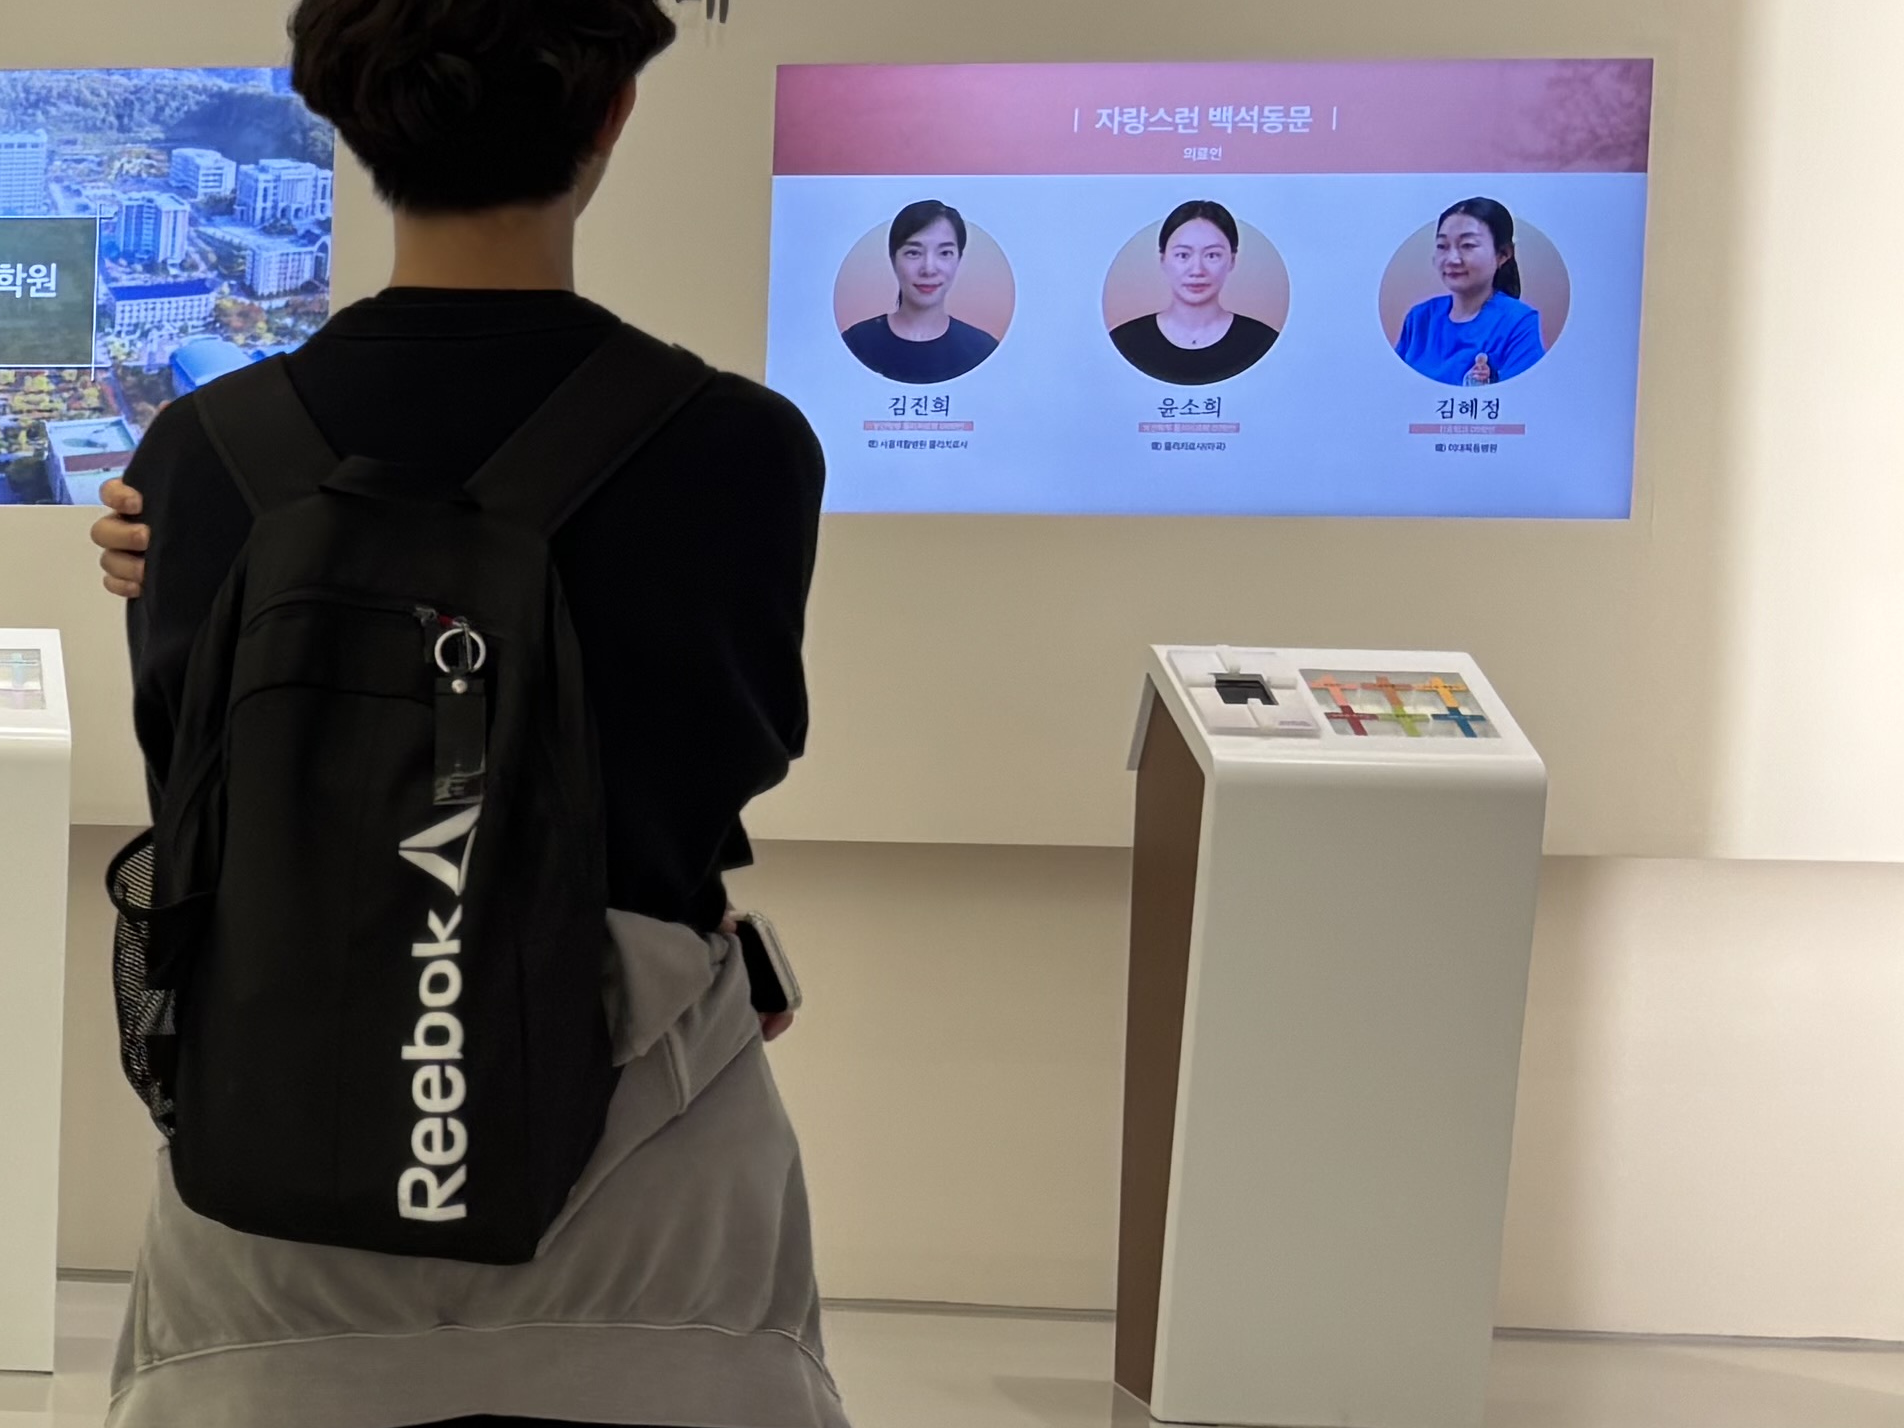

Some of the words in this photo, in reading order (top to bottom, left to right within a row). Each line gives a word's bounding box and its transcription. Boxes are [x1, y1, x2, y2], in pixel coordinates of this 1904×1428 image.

[1094, 106, 1200, 135] 자랑스런
[1207, 105, 1313, 134] 백석동문
[1183, 146, 1223, 161] 의료인
[888, 395, 950, 418] 김진희
[1156, 396, 1222, 419] 윤소희
[1434, 397, 1501, 421] 김혜정
[397, 903, 469, 1223] Reebok
